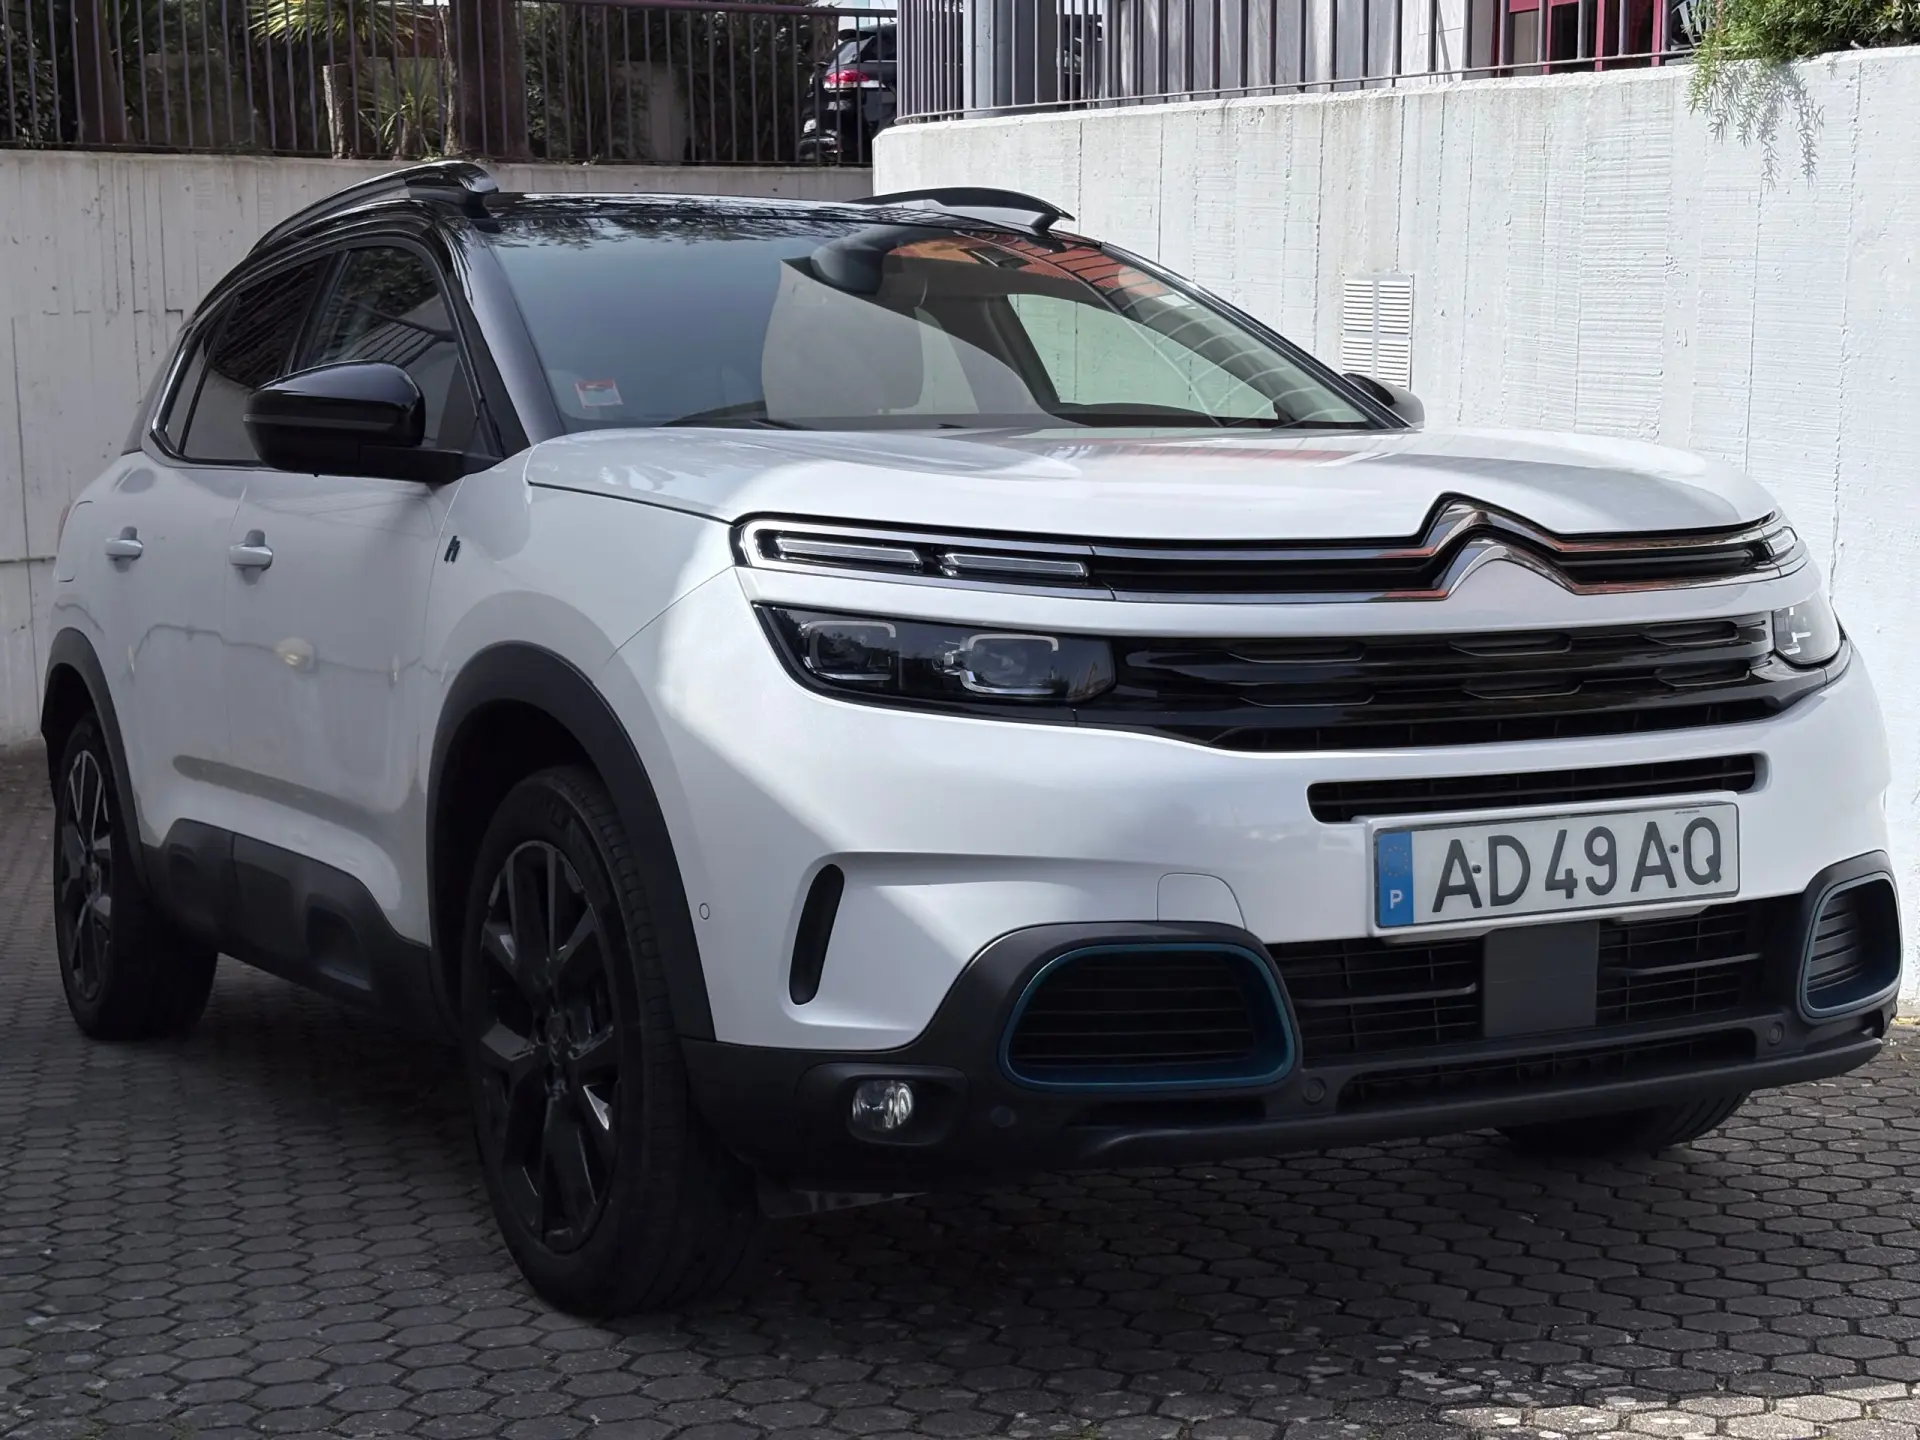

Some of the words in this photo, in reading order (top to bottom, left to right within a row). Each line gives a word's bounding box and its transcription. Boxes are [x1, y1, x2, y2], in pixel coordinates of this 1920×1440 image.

[1431, 834, 1531, 913] AD
[1544, 826, 1618, 899] 49
[1630, 817, 1722, 893] AQ
[1390, 889, 1403, 909] P
